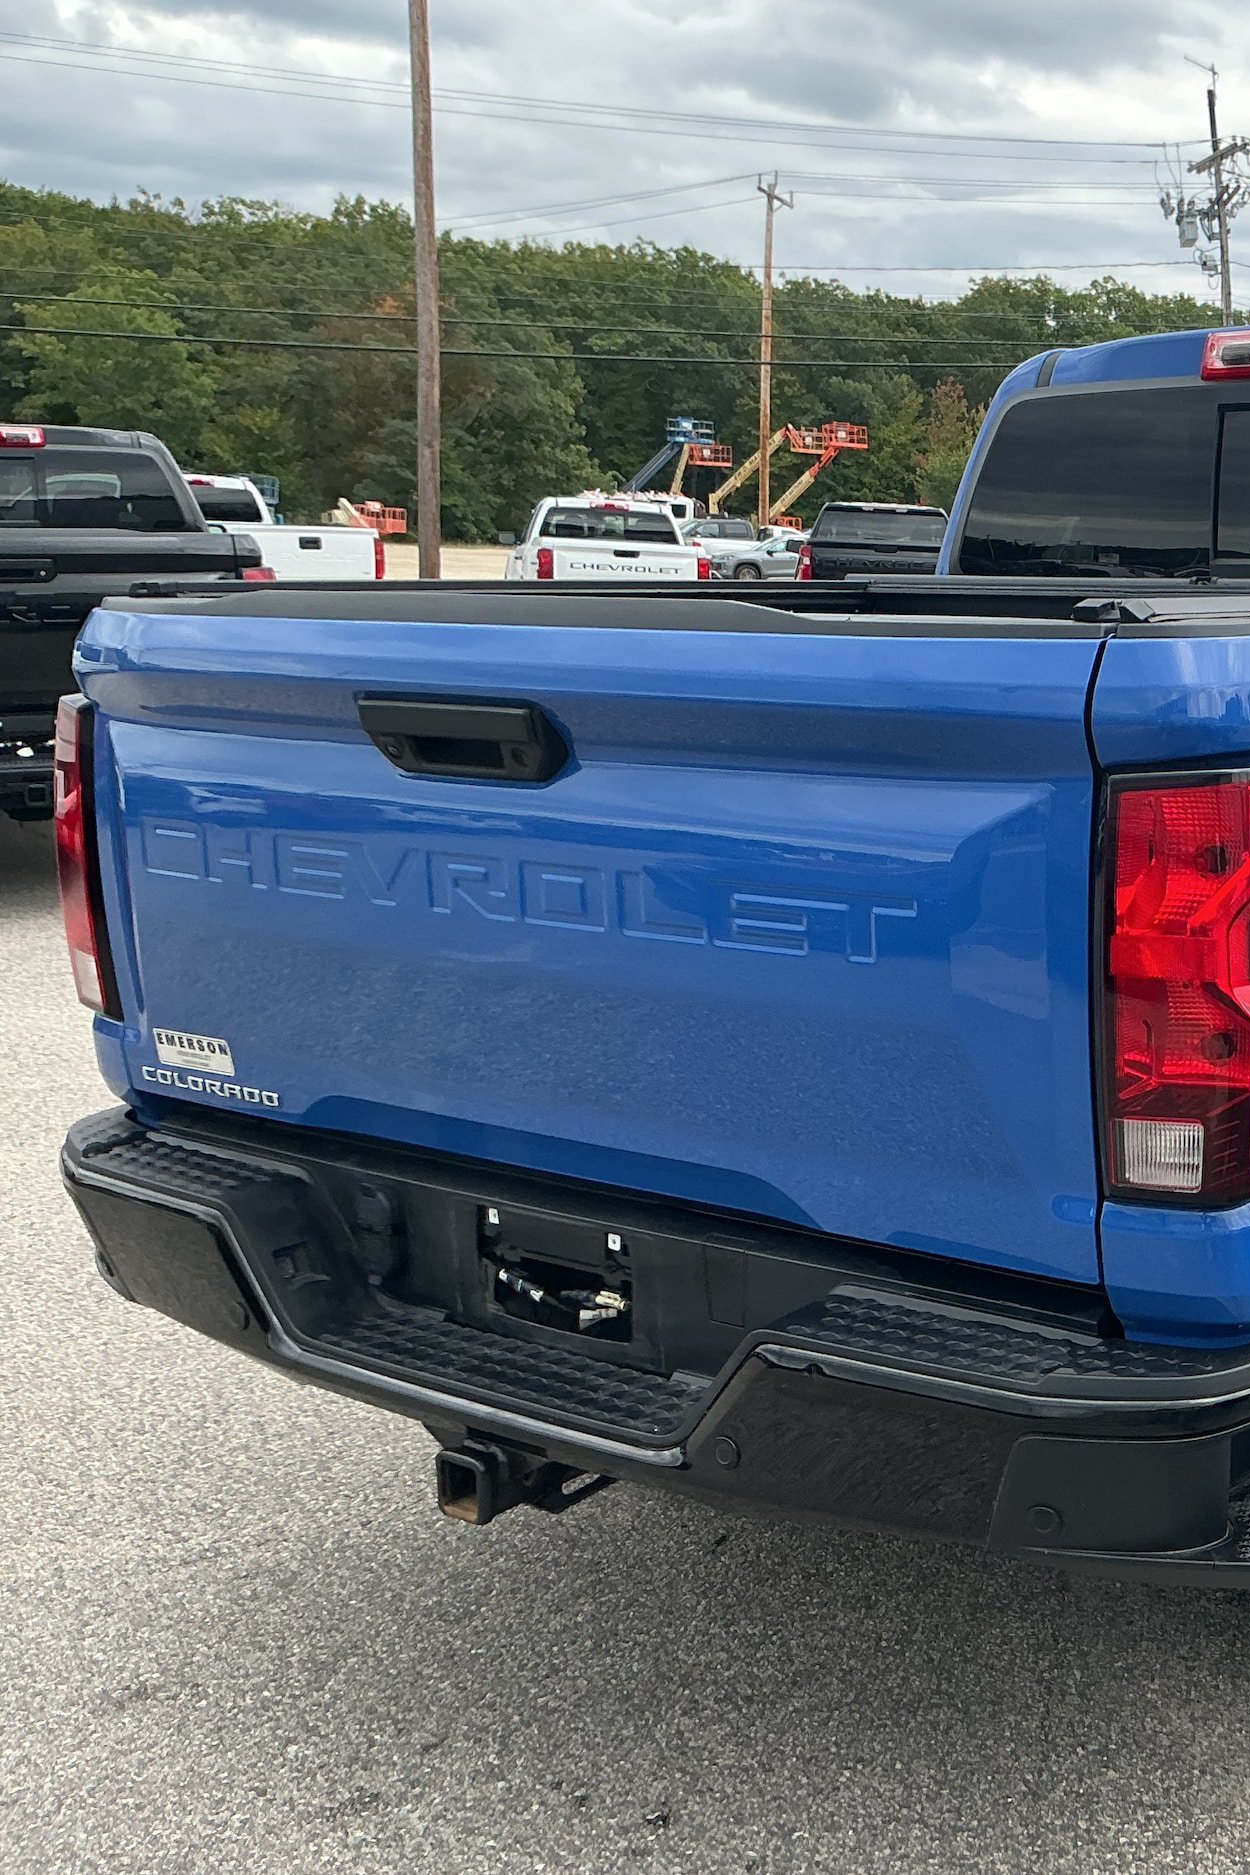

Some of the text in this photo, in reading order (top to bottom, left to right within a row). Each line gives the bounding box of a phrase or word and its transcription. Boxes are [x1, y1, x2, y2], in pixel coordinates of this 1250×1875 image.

[570, 561, 682, 575] CHEVROLET
[142, 818, 918, 963] CHEVROLET
[156, 1032, 229, 1056] EMERSON
[141, 1065, 280, 1107] COLORADO
